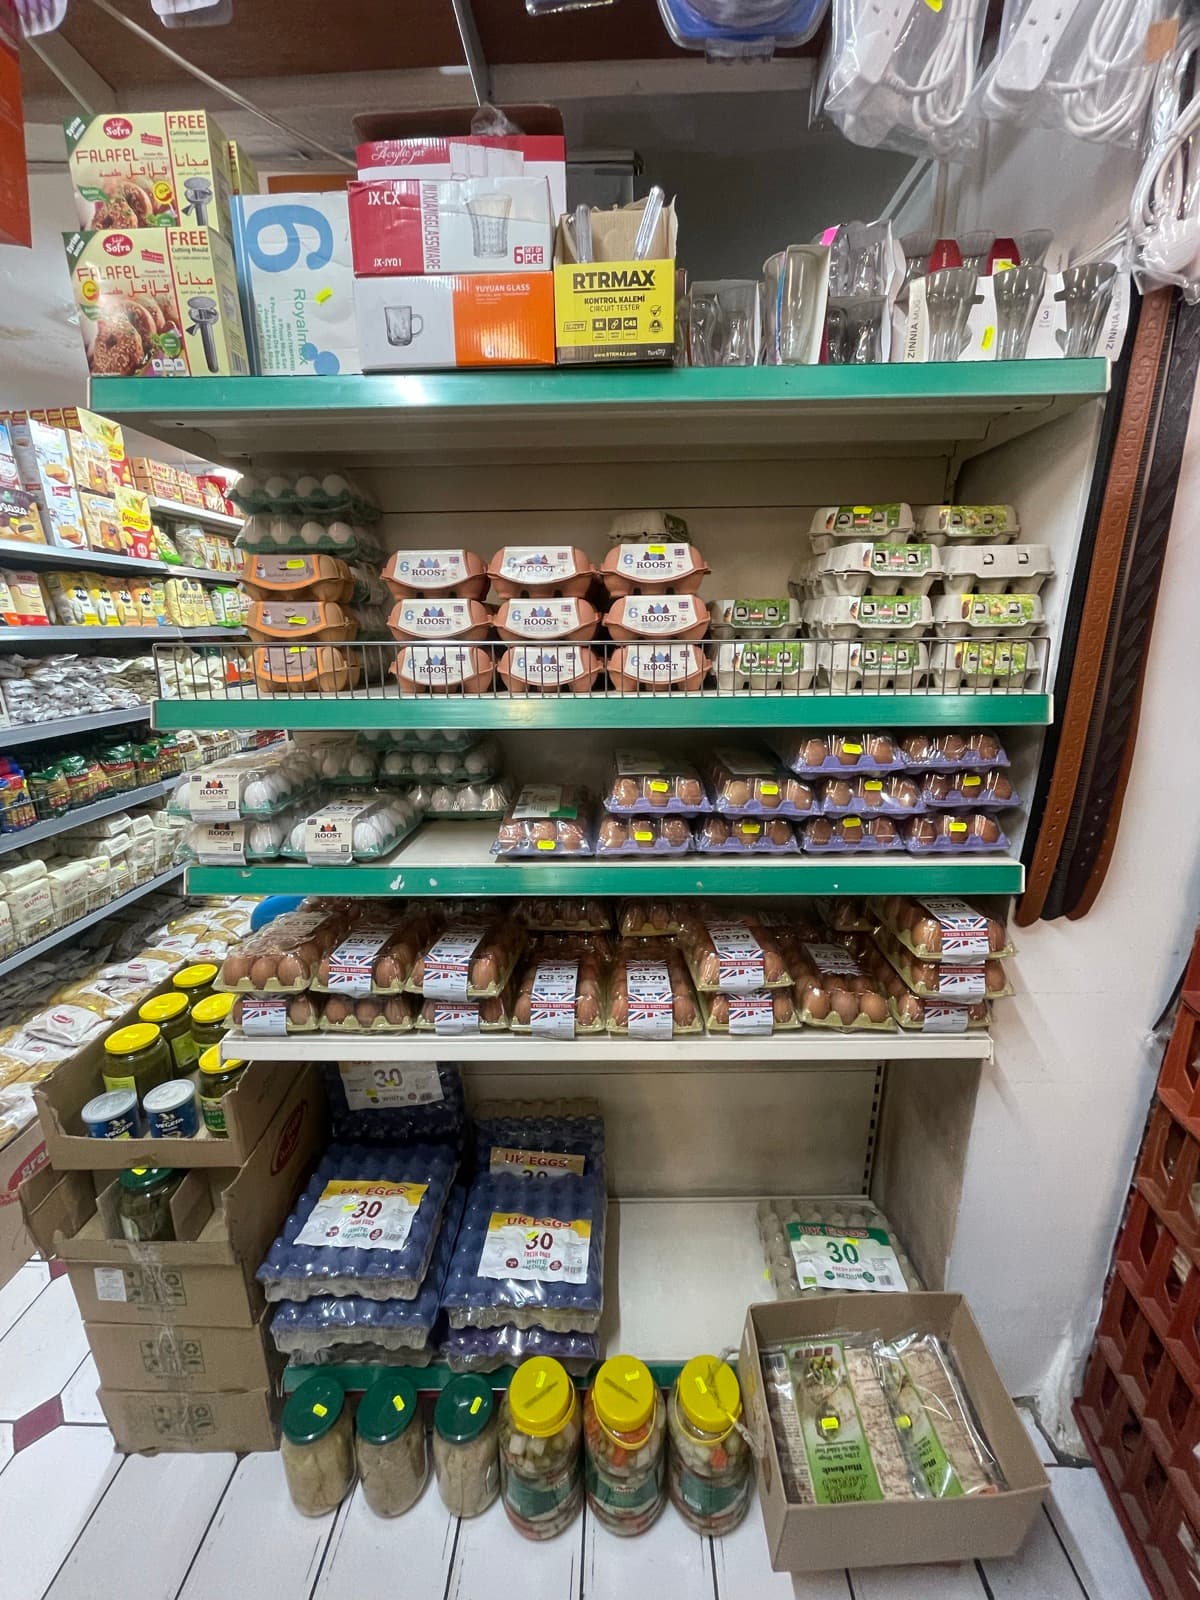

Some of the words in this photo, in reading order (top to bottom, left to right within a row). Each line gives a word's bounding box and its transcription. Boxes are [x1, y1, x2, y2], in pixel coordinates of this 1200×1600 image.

[168, 114, 206, 129] FREE
[105, 127, 130, 136] Sofra
[170, 231, 208, 246] FREE
[246, 204, 333, 272] 6
[105, 243, 131, 253] Sofra
[513, 246, 524, 265] 6
[525, 253, 544, 264] PCE
[572, 269, 656, 290] RTRMAX
[475, 285, 505, 293] YUYUAN
[506, 283, 531, 292] GLASS
[584, 296, 618, 305] KONTROL
[589, 304, 615, 313] CIRCUIT
[617, 303, 640, 311] TESTER
[907, 322, 919, 359] ZINNIA
[1105, 319, 1119, 351] ZINNIA
[624, 554, 634, 565] 6
[636, 561, 672, 569] ROOST
[400, 561, 410, 573] 6
[411, 568, 447, 577] ROOST
[405, 610, 415, 622] 6
[512, 610, 521, 622] 6
[628, 607, 639, 618] 6
[641, 614, 677, 622] ROOST
[416, 617, 451, 626] ROOST
[523, 617, 559, 626] ROOST
[419, 665, 454, 674] ROOST
[528, 664, 564, 673] ROOST
[643, 663, 679, 671] ROOST
[199, 788, 229, 796] ROOST
[208, 829, 235, 837] ROOST
[374, 1068, 403, 1088] 30
[155, 1118, 184, 1128] VEGETA
[505, 1153, 523, 1163] UK
[529, 1156, 569, 1168] EGGS
[365, 1185, 408, 1196] EGGS
[352, 1200, 383, 1219] 30
[507, 1217, 528, 1225] UK
[533, 1217, 572, 1228] EGGS
[525, 1232, 553, 1250] 30
[826, 1241, 859, 1265] 30
[836, 1272, 863, 1280] MEDIUM
